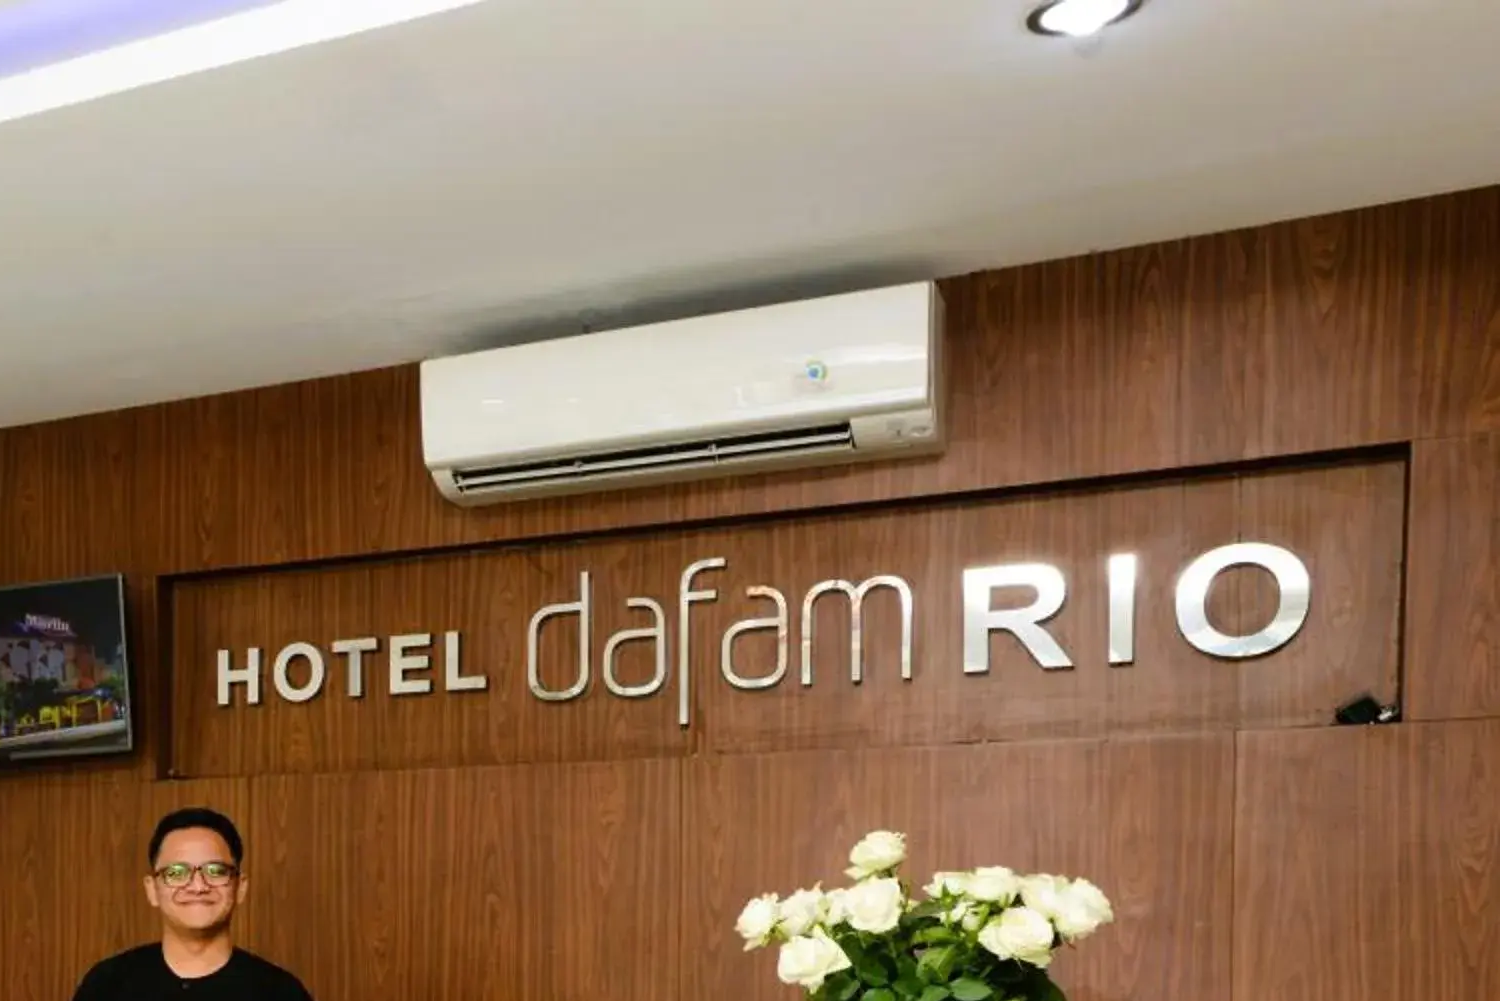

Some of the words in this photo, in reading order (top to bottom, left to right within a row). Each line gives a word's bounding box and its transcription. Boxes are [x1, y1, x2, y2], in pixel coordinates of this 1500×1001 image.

[217, 630, 487, 705] HOTEL
[527, 556, 914, 726] dafam
[962, 541, 1311, 675] RIO
